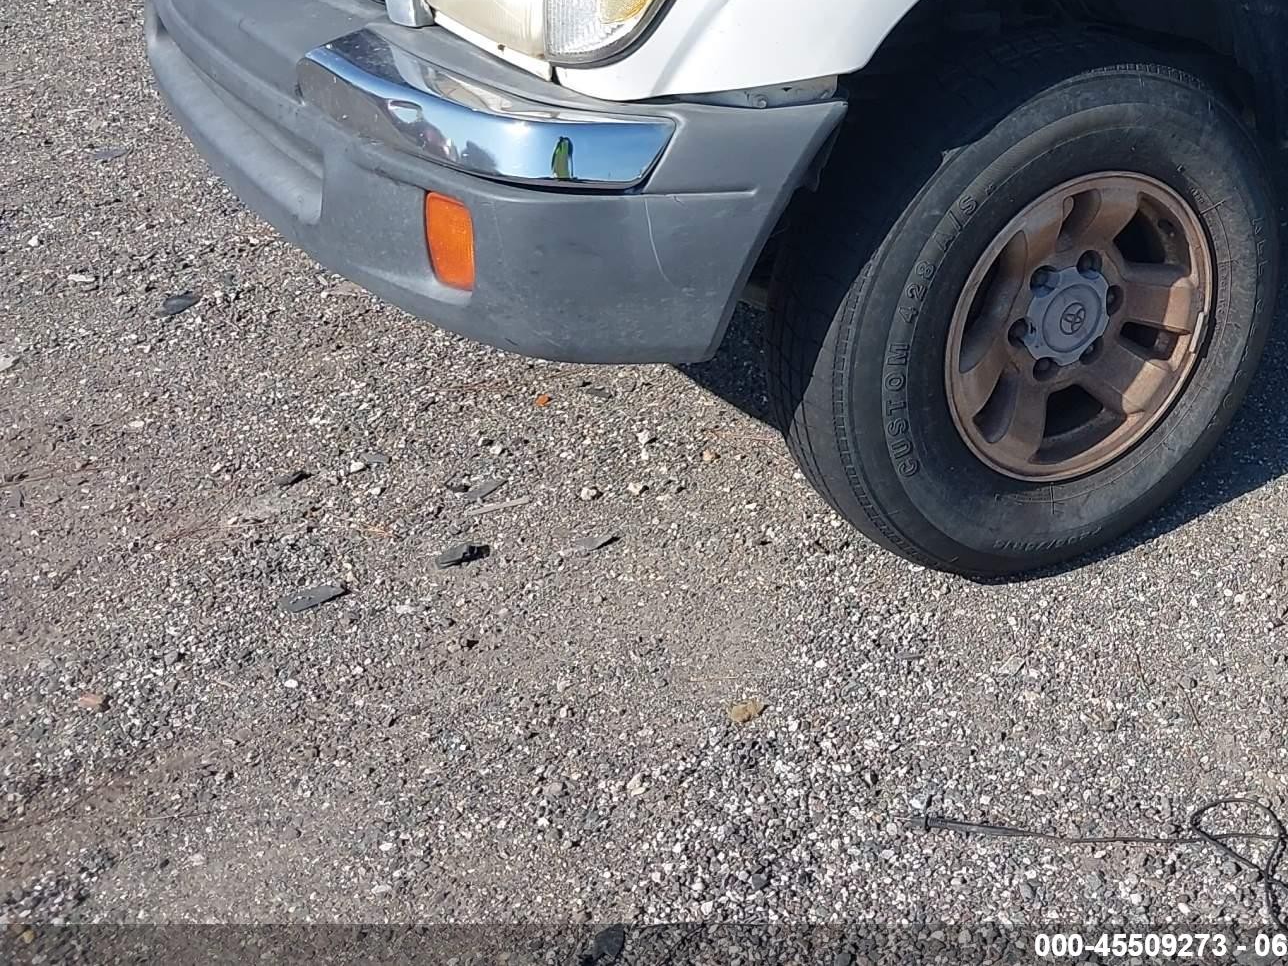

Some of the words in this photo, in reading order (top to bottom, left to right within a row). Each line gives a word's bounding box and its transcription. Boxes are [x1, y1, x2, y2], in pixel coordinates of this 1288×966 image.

[934, 194, 978, 251] A/S
[899, 260, 937, 324] 428
[885, 342, 919, 478] CUSTOM
